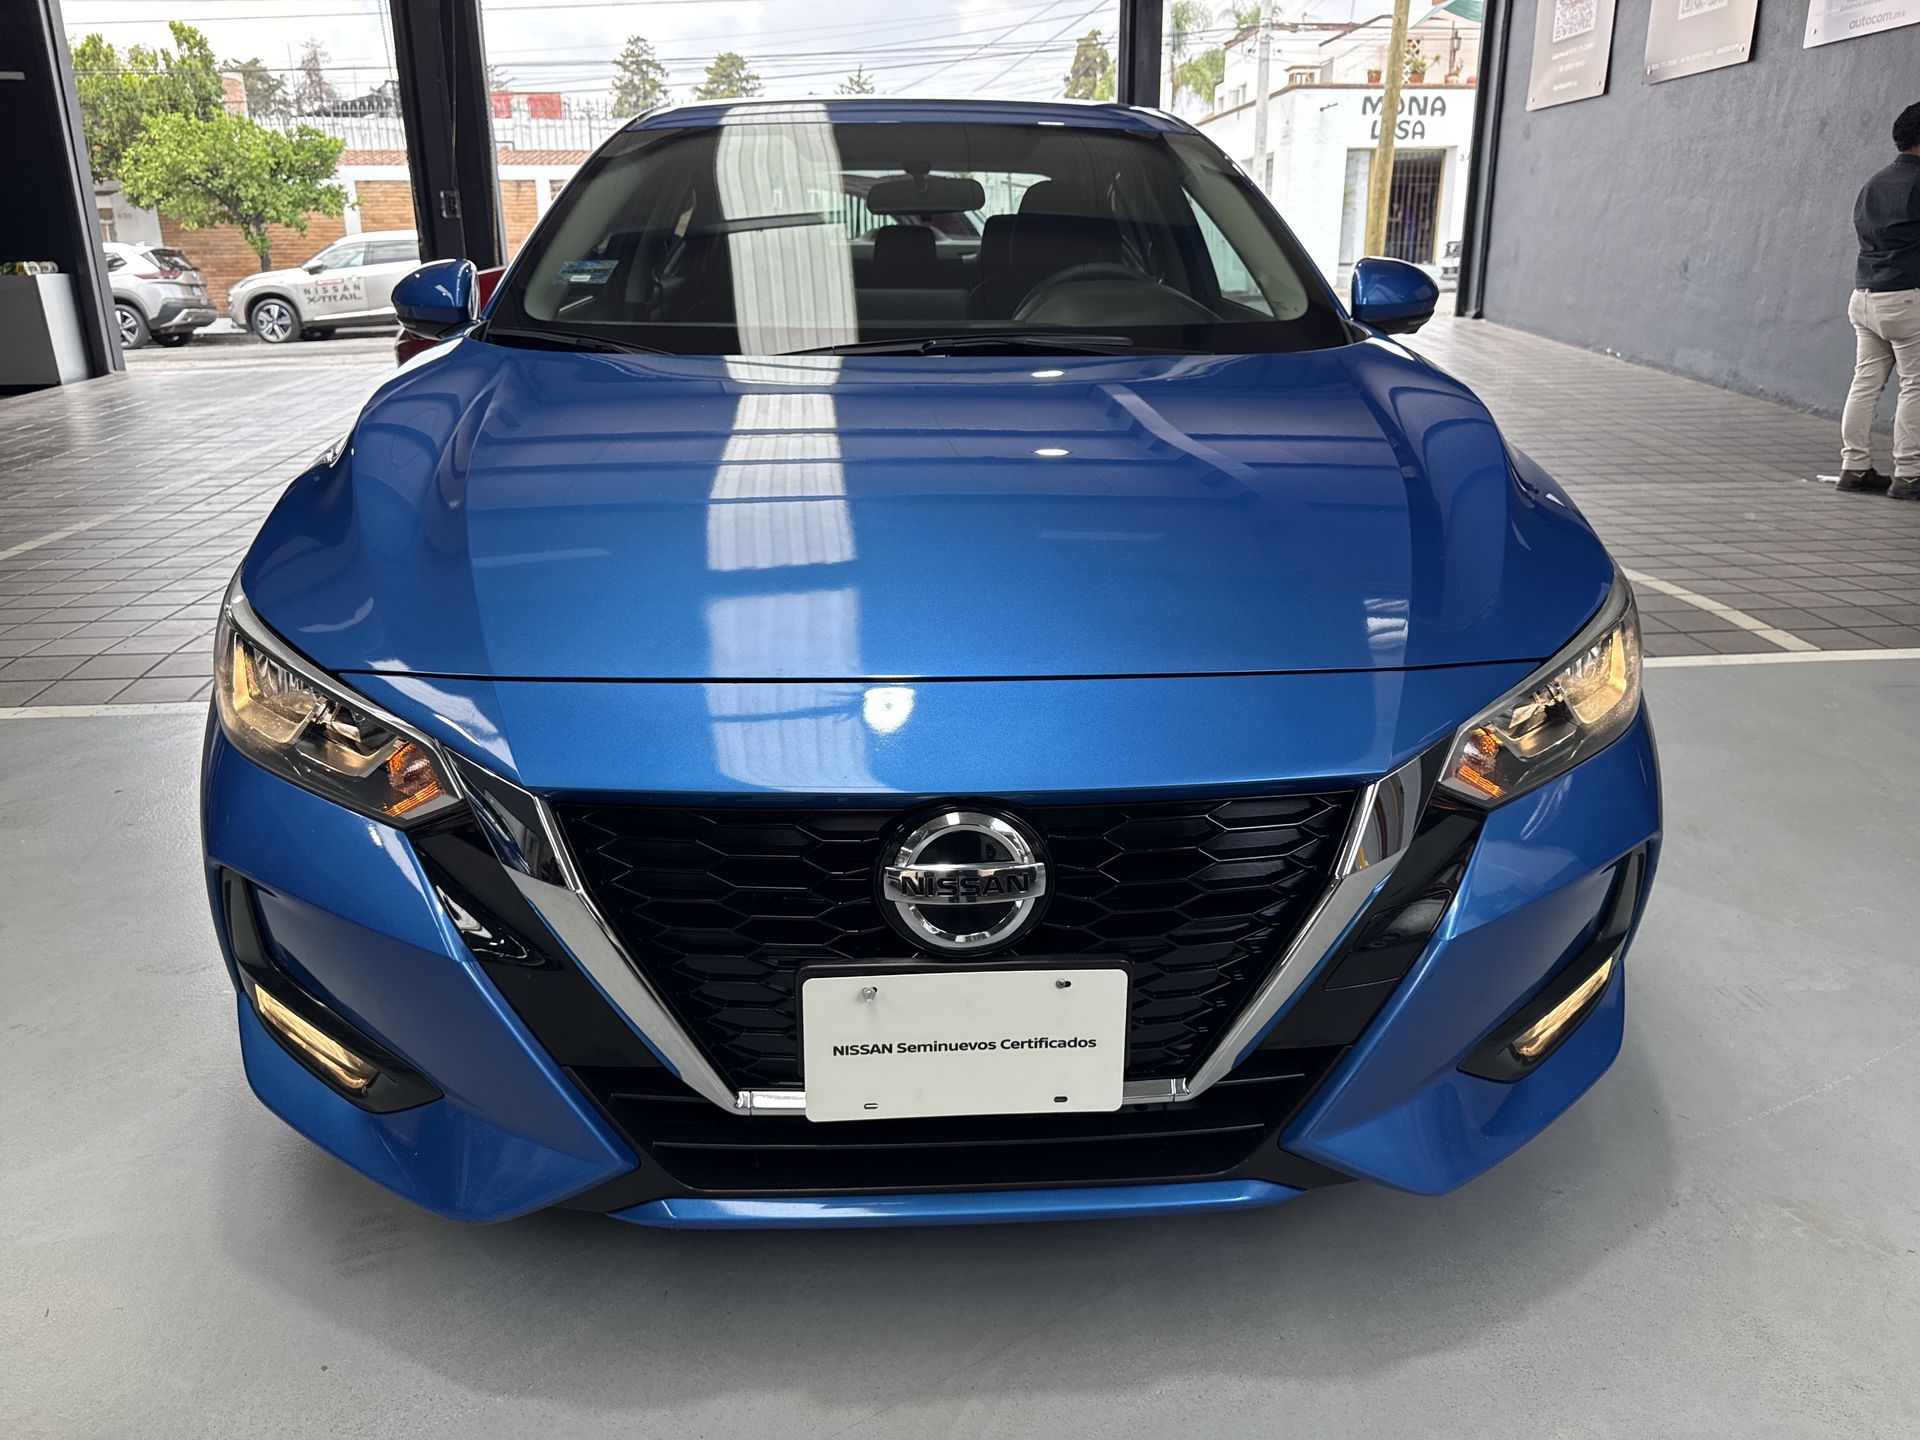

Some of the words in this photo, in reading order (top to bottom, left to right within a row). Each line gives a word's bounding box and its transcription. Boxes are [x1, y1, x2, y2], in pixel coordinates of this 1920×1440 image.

[1370, 119, 1426, 140] LSA
[303, 283, 361, 295] NISSAN
[901, 873, 1030, 898] NISSAN
[833, 1043, 893, 1057] NISSAN
[897, 1040, 997, 1054] Seminuevos
[1000, 1037, 1097, 1050] Certificados
